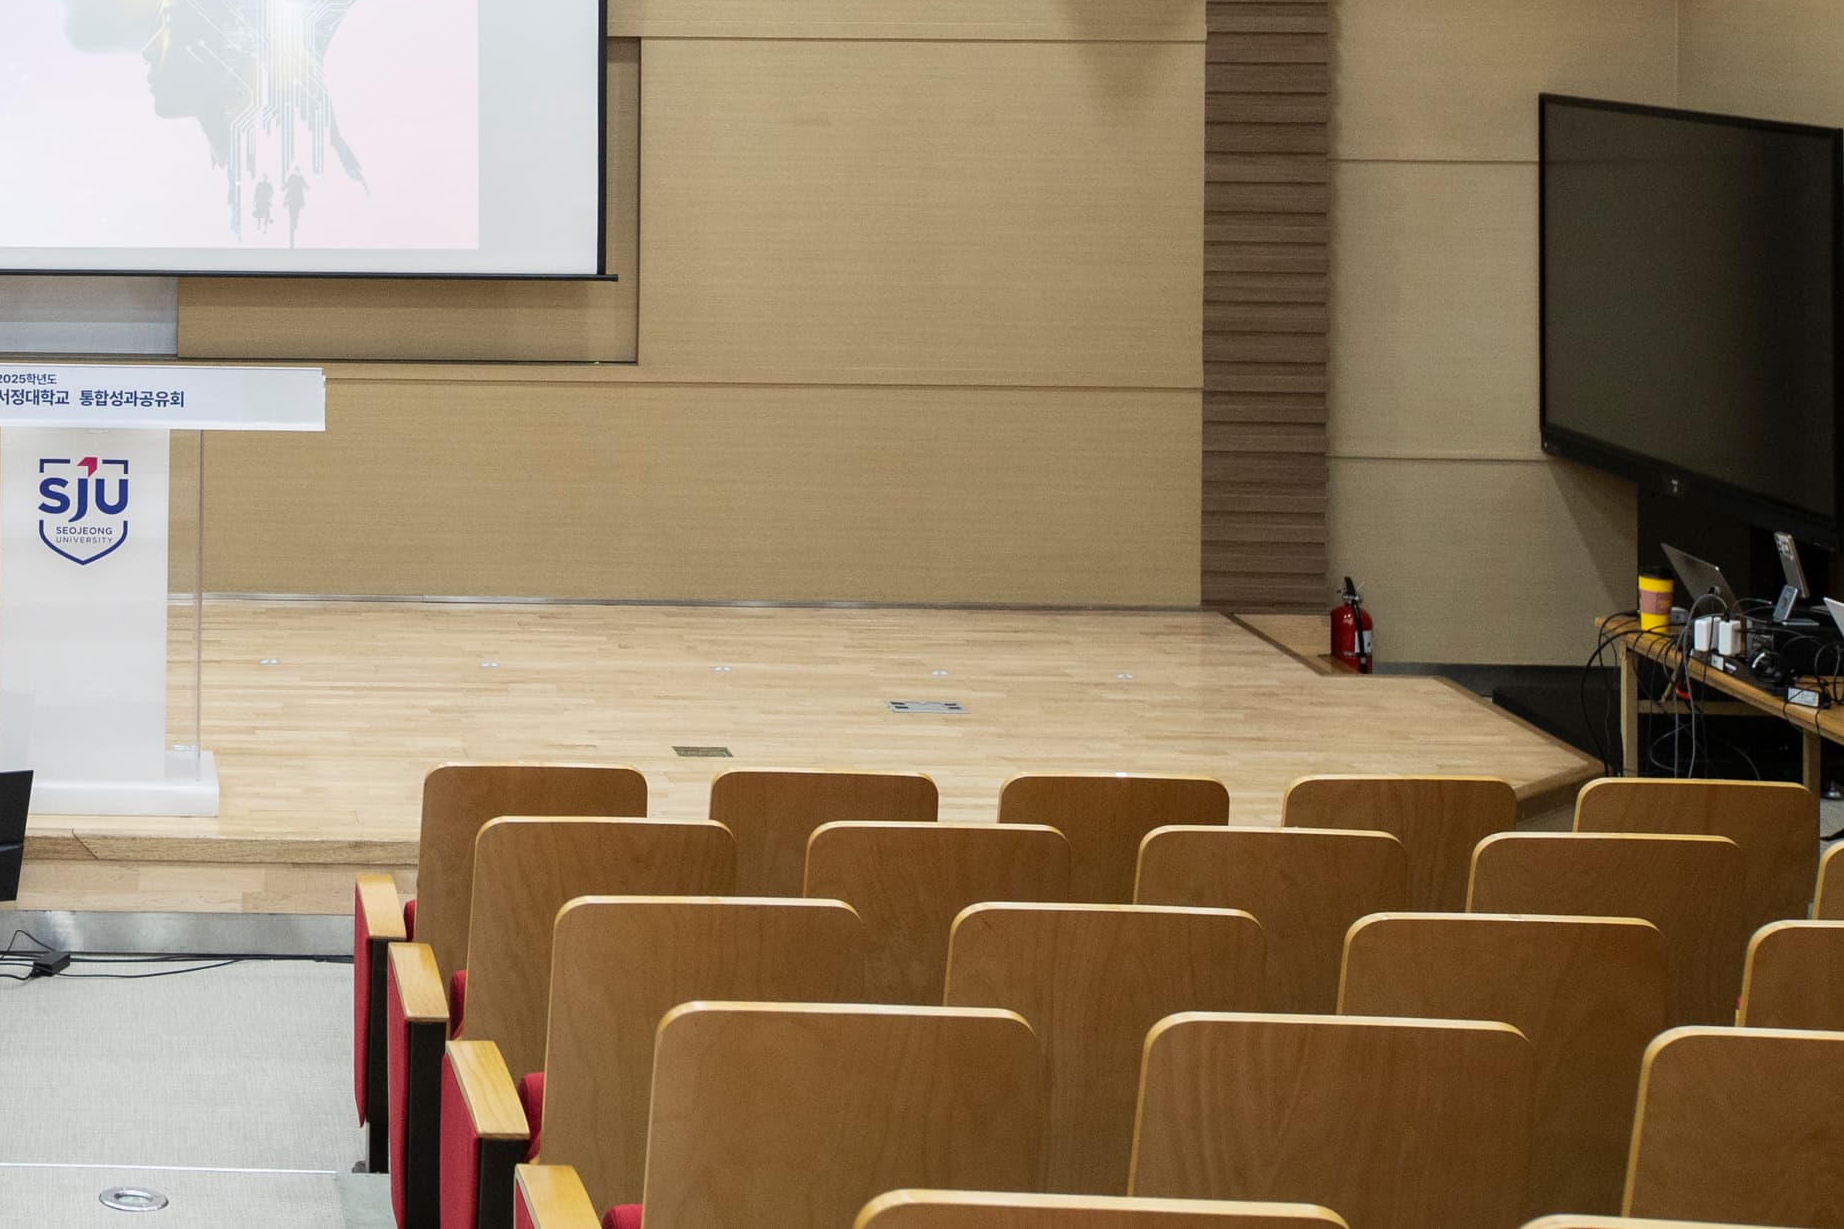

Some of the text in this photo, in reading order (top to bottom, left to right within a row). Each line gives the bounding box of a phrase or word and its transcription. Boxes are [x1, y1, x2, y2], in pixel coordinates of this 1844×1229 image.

[79, 389, 185, 408] 통합성과공유회
[55, 526, 113, 536] SEOJEONG
[55, 536, 114, 544] UNIVERSITY
